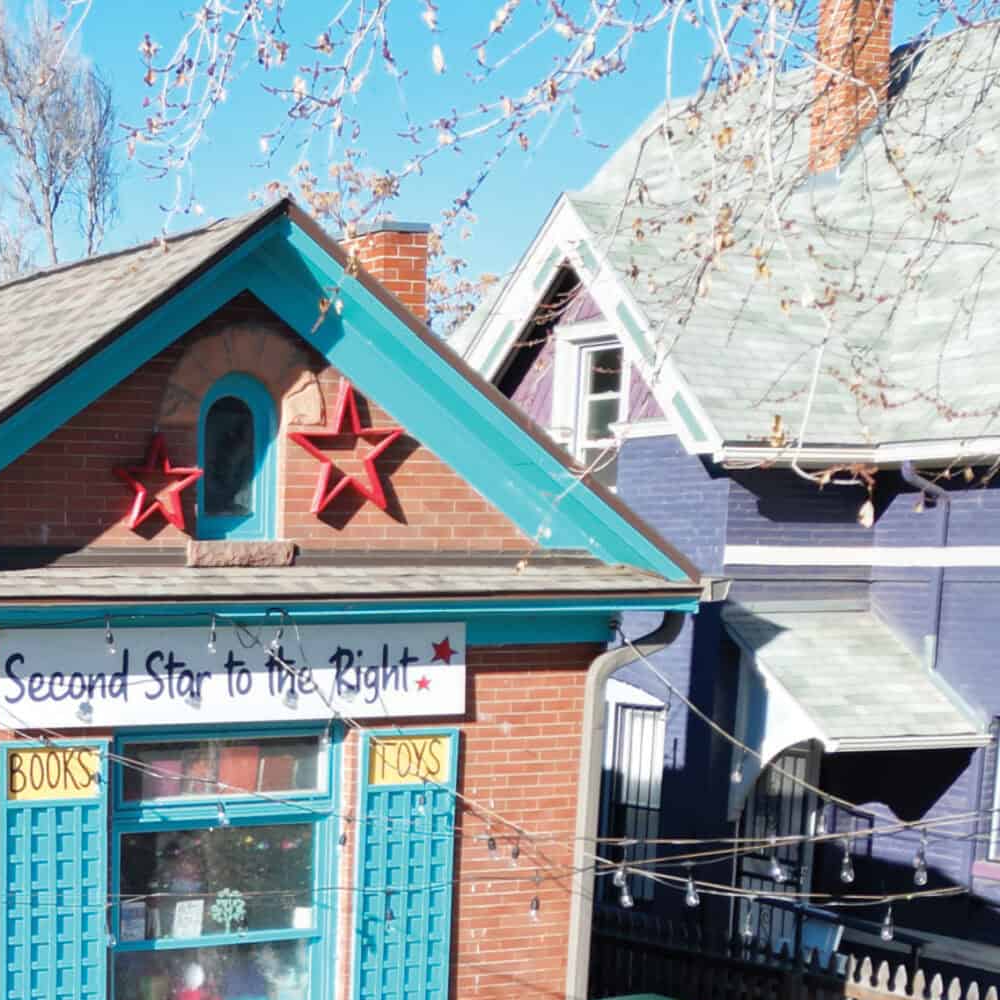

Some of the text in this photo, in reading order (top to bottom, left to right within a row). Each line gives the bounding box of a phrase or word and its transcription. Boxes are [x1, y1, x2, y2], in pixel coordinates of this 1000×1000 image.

[4, 643, 420, 705] Second Star to the Right
[8, 746, 93, 794] BOOKS
[370, 738, 443, 780] TOYS
